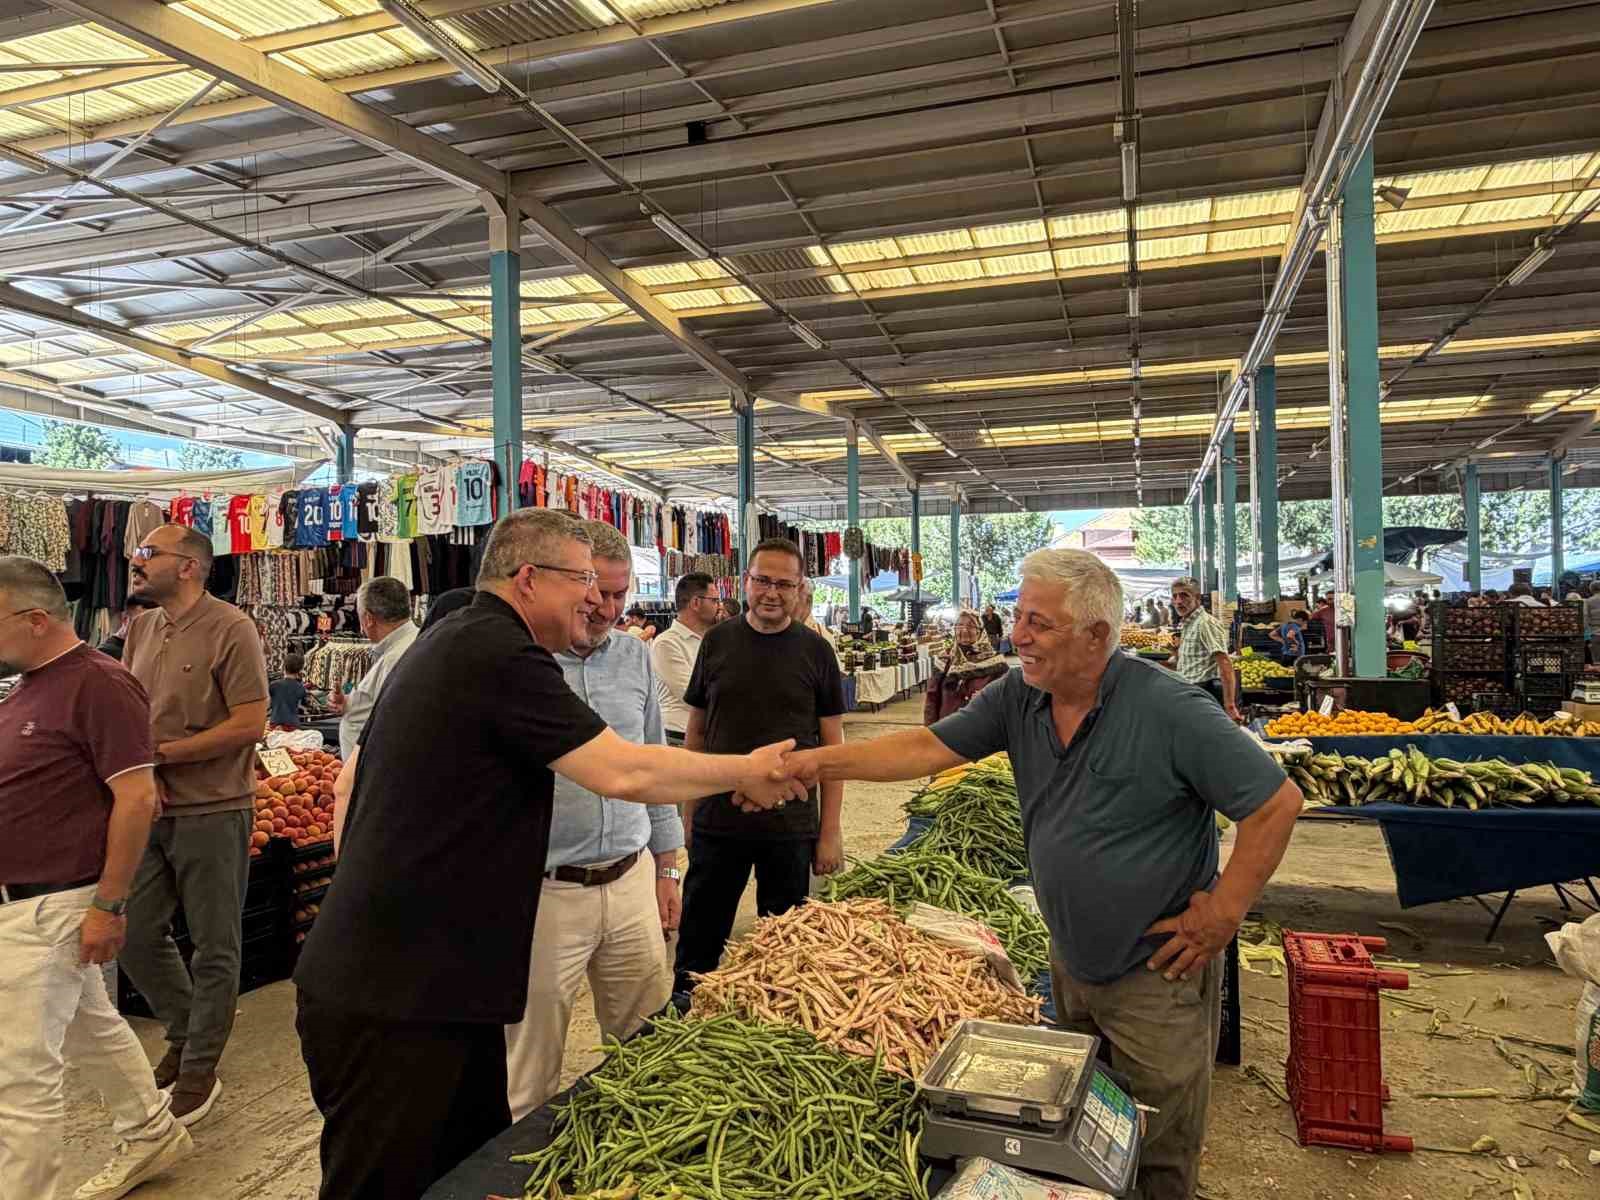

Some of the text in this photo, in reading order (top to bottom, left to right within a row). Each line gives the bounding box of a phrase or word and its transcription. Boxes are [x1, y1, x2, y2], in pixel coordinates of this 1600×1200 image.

[463, 477, 483, 501] 10
[304, 503, 323, 526] 20
[329, 501, 343, 521] 10
